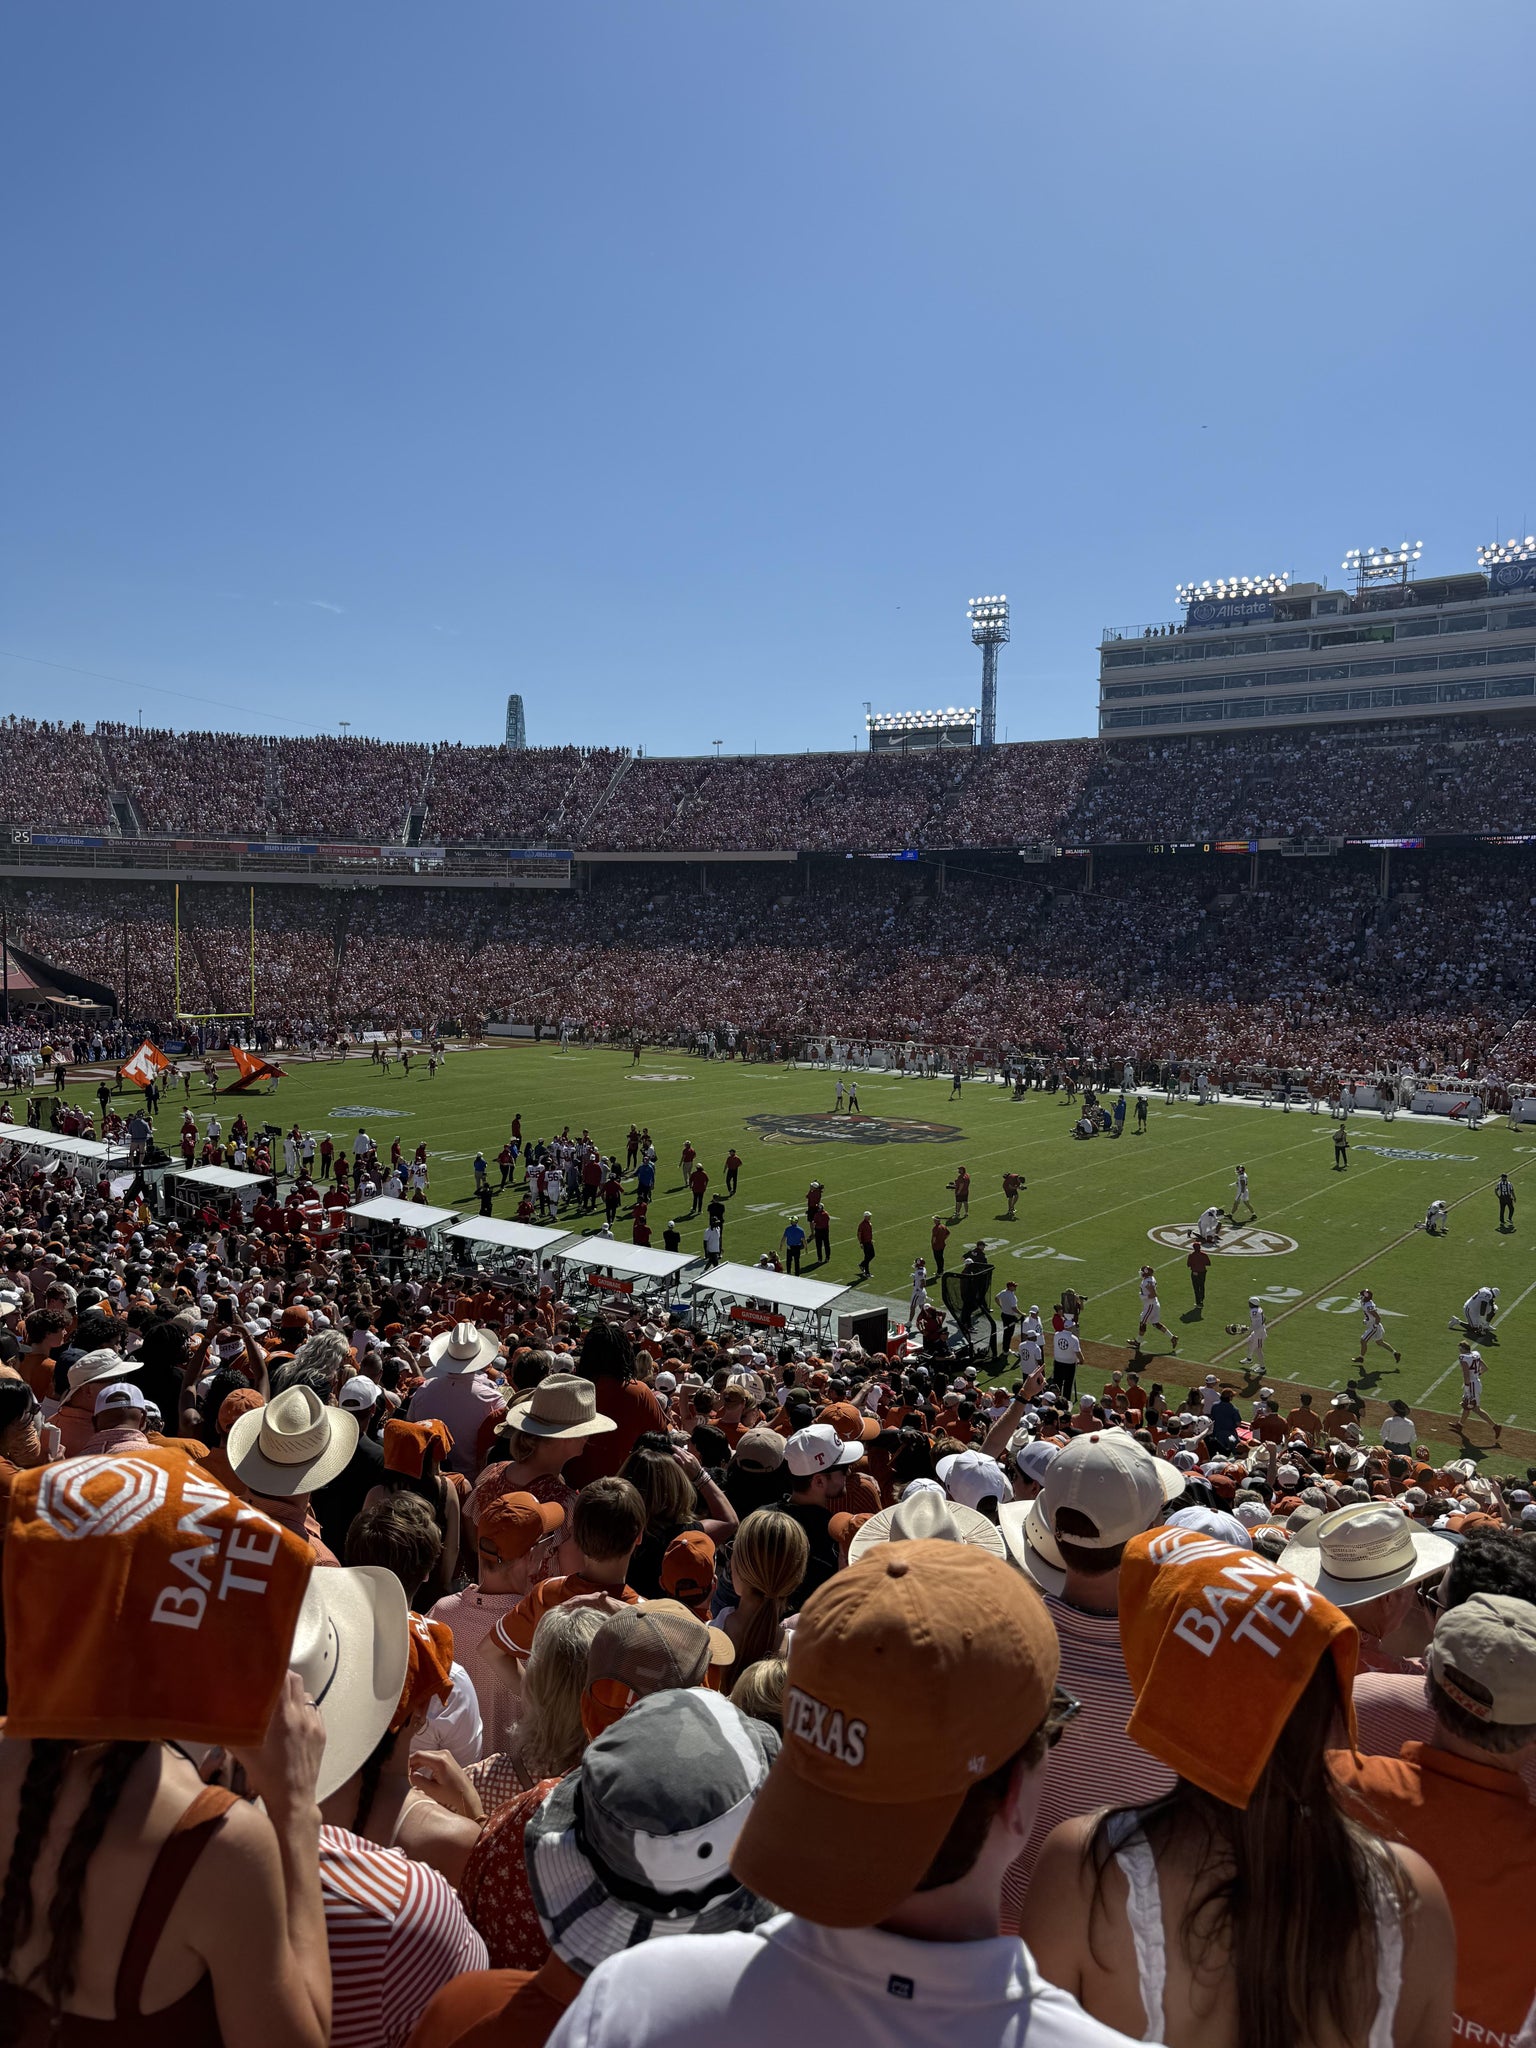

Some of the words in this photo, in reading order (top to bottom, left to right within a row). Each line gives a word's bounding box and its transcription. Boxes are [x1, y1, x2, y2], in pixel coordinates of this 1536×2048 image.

[1216, 602, 1266, 618] Allstate
[14, 831, 30, 843] 25
[57, 837, 84, 845] Allstate
[281, 845, 301, 853] LIGHT
[547, 1172, 558, 1181] 56
[260, 1254, 267, 1265] 6
[741, 1311, 771, 1323] GATORADE
[814, 1452, 825, 1466] T
[786, 1686, 867, 1767] TEXAS
